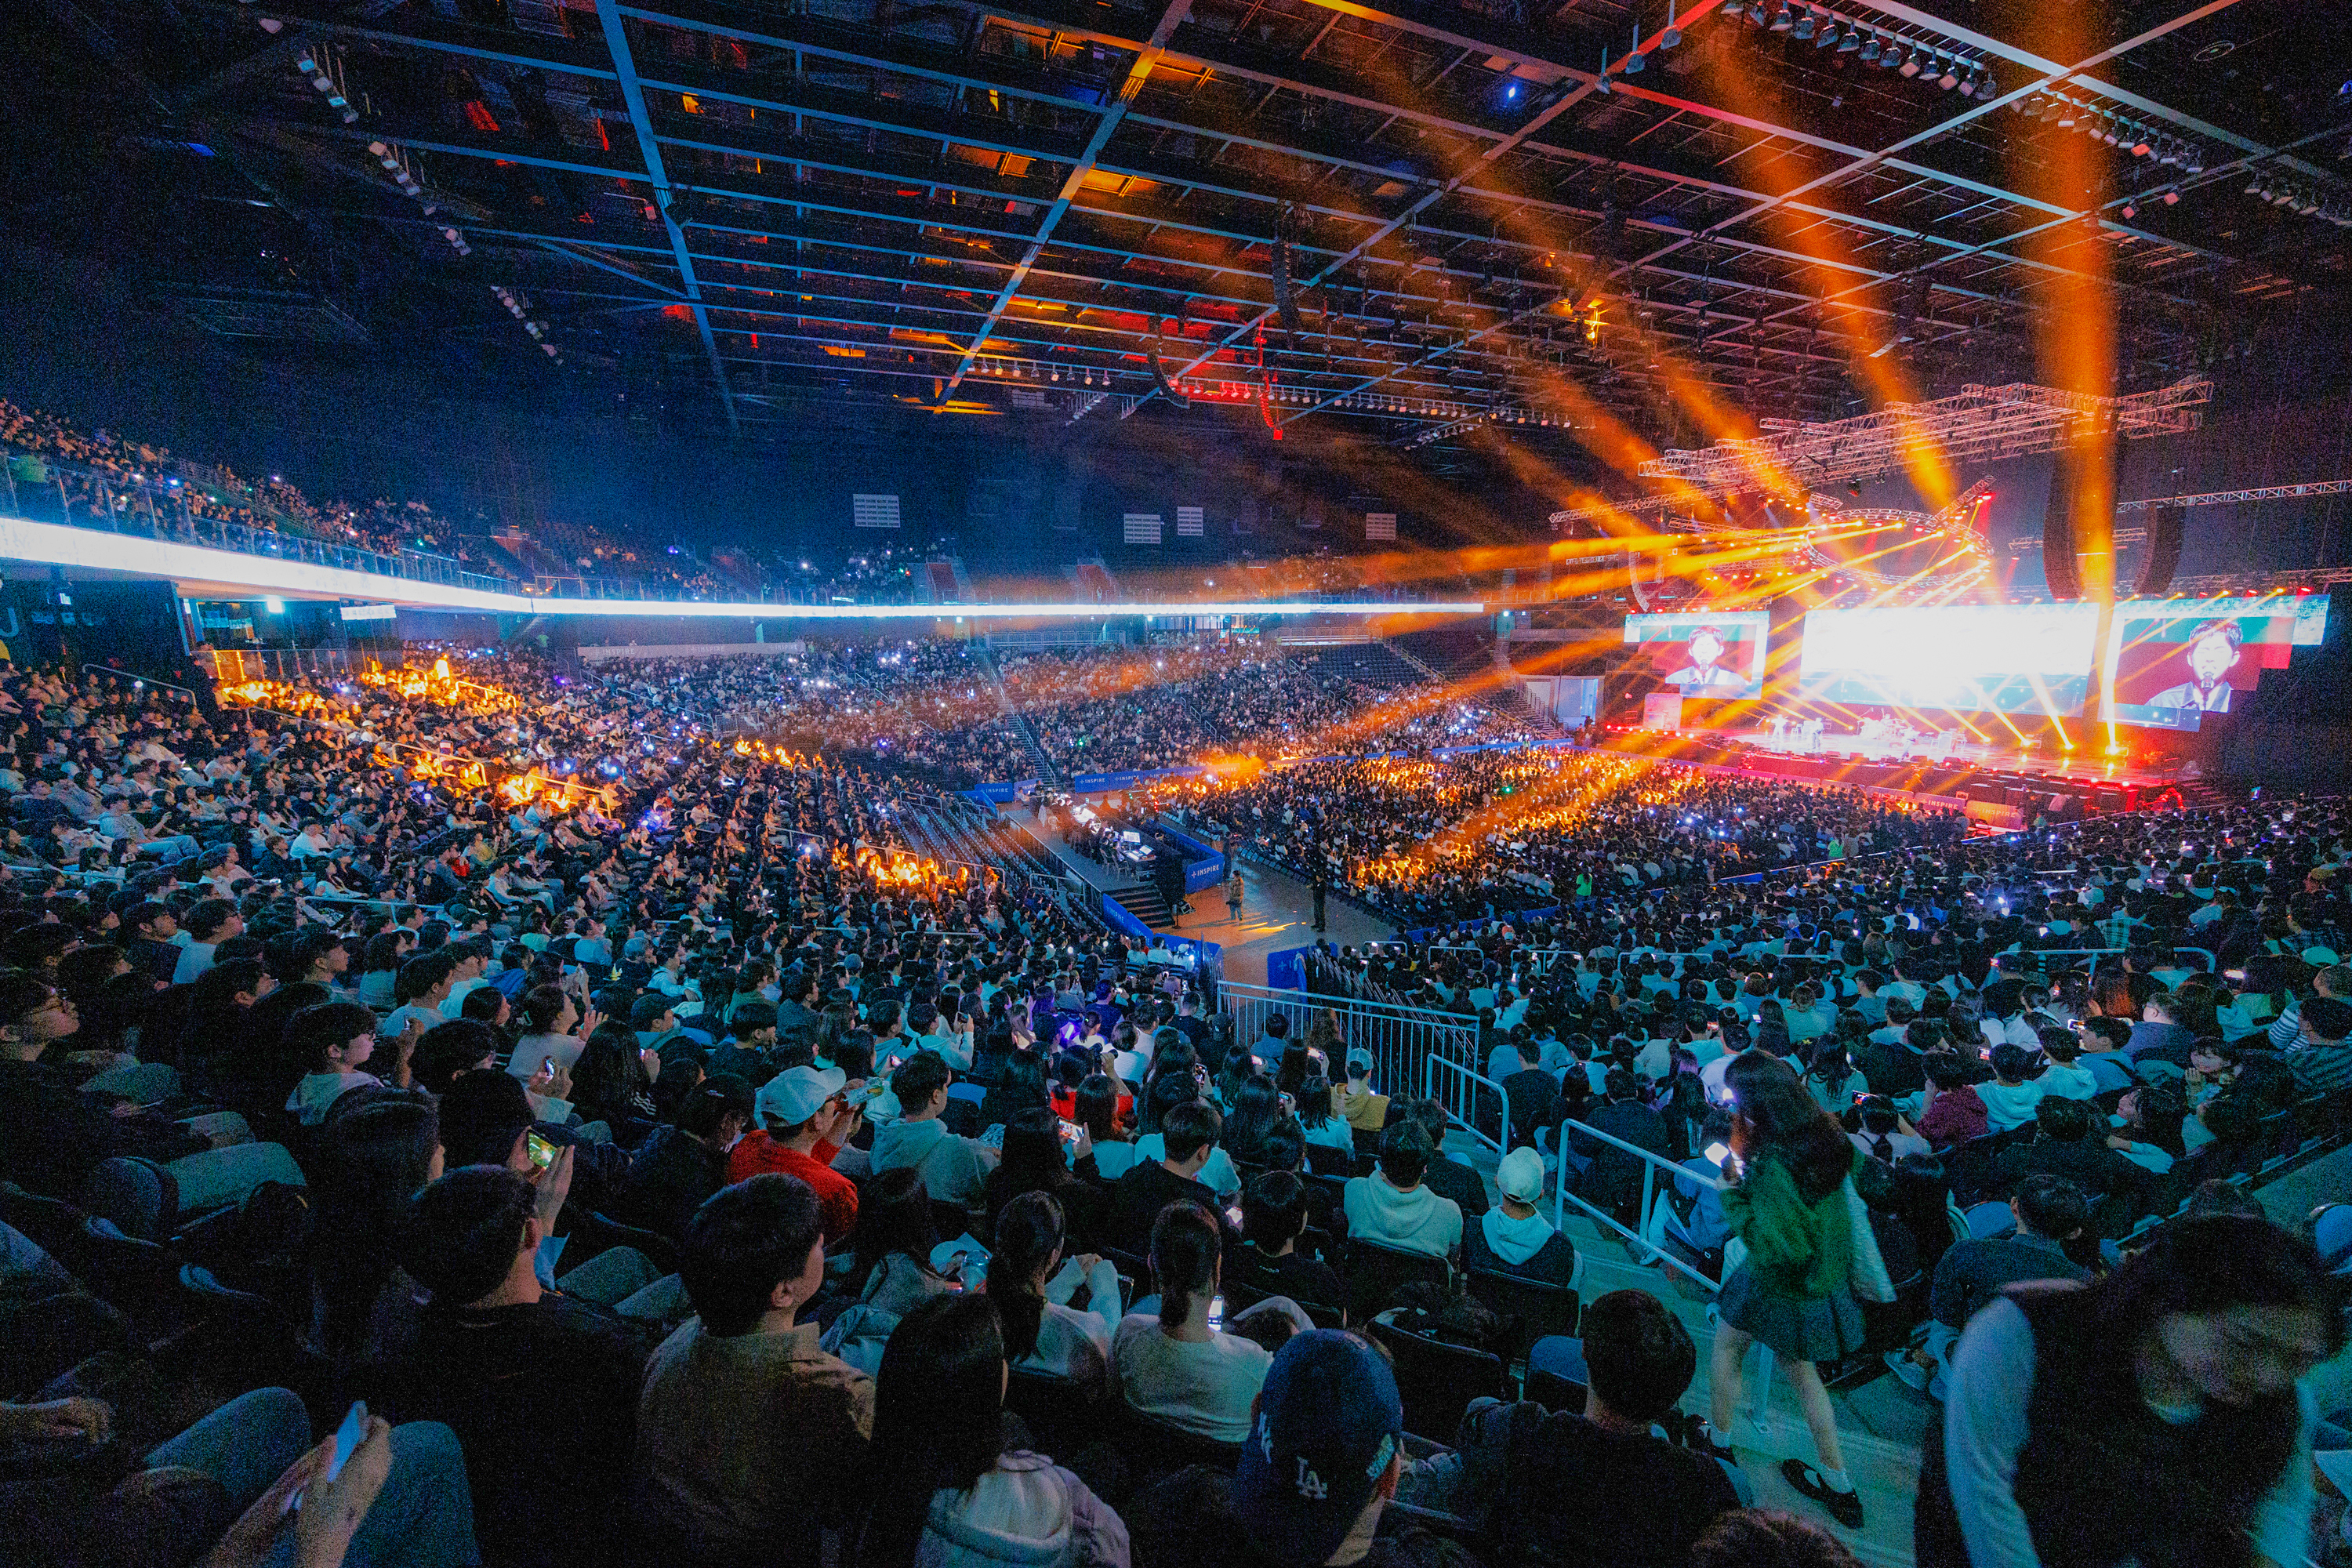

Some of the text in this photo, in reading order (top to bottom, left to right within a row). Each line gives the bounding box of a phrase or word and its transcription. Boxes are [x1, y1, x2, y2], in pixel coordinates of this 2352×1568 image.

[1928, 800, 1958, 810] INSPIRE
[1982, 808, 2016, 818] INSPIRE
[1197, 864, 1220, 877] INSPIRE
[1295, 1456, 1328, 1499] LA
